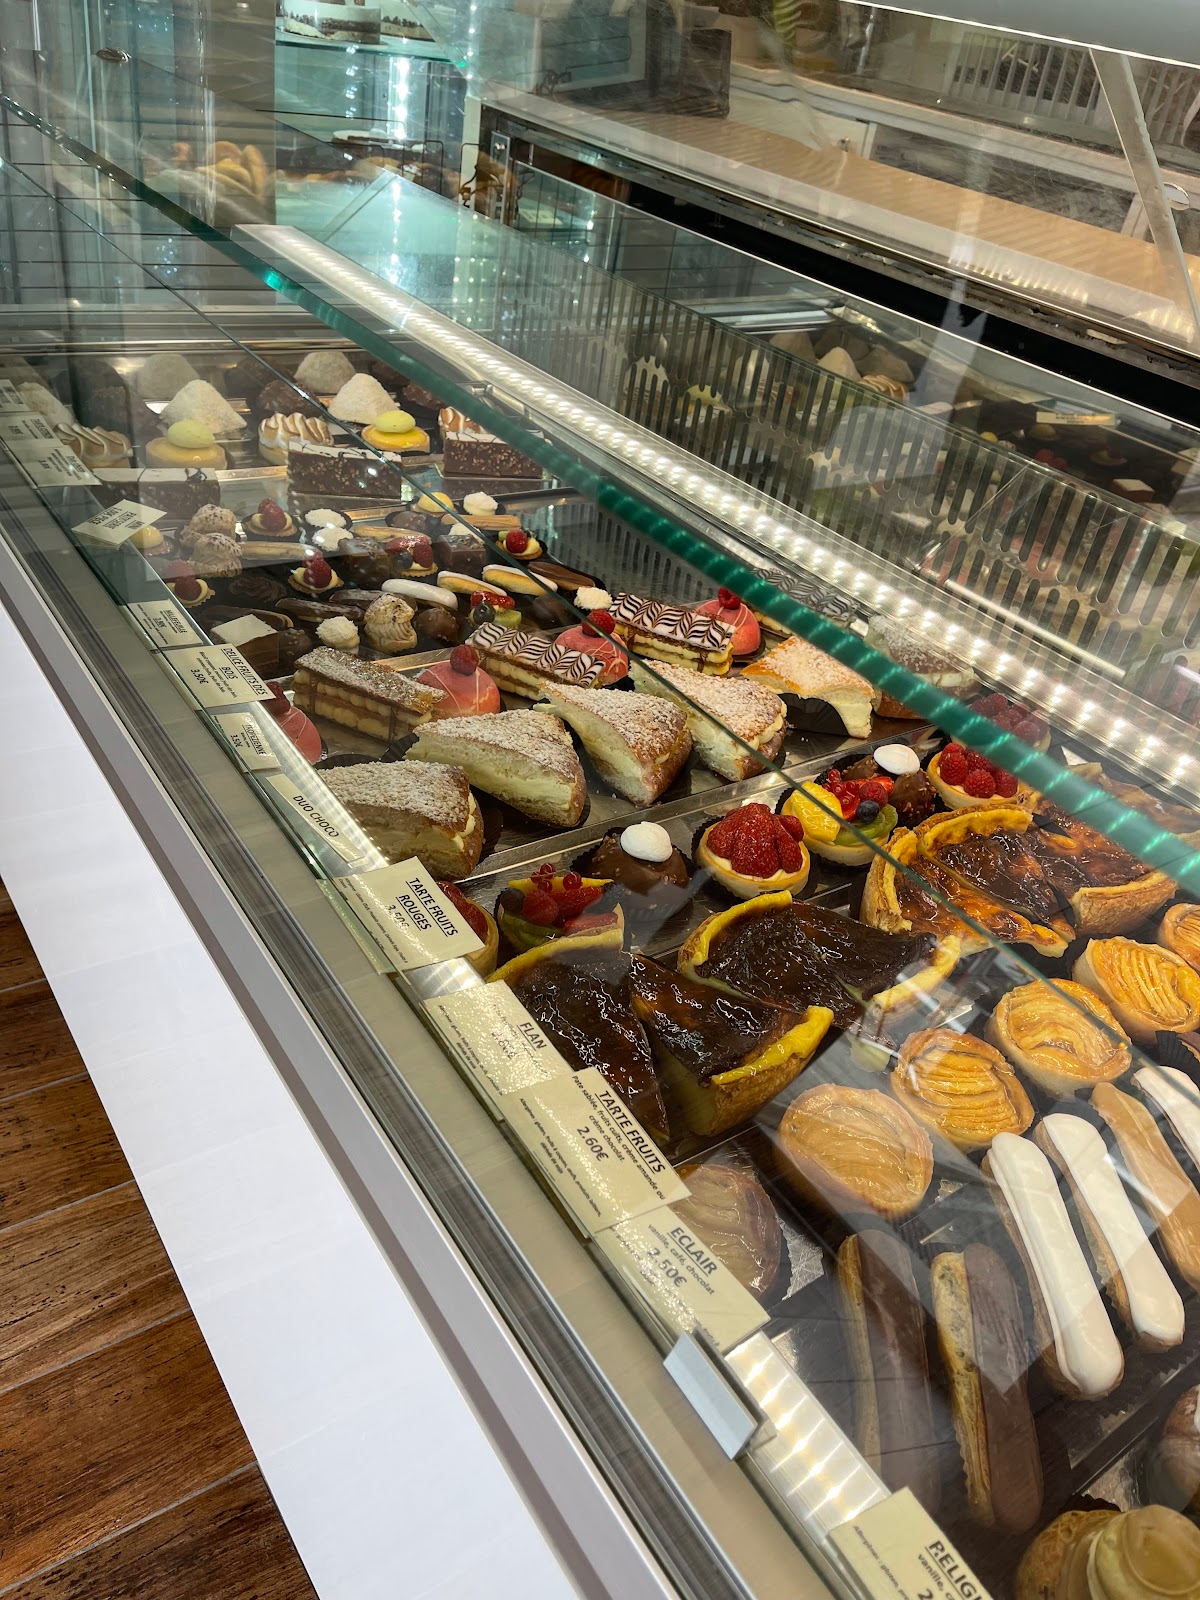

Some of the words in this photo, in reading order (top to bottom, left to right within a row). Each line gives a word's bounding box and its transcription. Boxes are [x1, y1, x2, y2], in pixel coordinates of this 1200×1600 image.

[191, 669, 208, 684] 3.50€
[222, 667, 238, 680] BOIS
[224, 648, 244, 665] DELICE
[238, 664, 258, 684] FRUITS
[252, 684, 268, 695] DES
[245, 724, 266, 754] TROPEZIENNE
[293, 796, 314, 812] DUO
[310, 812, 339, 838] CHOCO
[398, 894, 432, 930] ROUGES
[409, 878, 436, 906] TARTE
[429, 906, 458, 936] FRUITS
[520, 1022, 546, 1049] FLAN
[576, 1126, 609, 1162] 2.60€
[582, 1089, 598, 1110] sablée,
[597, 1110, 610, 1126] fruits
[610, 1126, 622, 1144] cuits,
[622, 1144, 638, 1163] crème
[636, 1163, 658, 1190] amande
[656, 1190, 666, 1200] ou
[589, 1115, 604, 1134] crème
[603, 1134, 625, 1163] chocolat.
[600, 1090, 632, 1128] TARTE
[626, 1130, 666, 1173] FRUITS
[648, 1224, 669, 1248] vanille,
[670, 1248, 685, 1266] café,
[686, 1265, 715, 1295] chocolat
[670, 1227, 718, 1274] ECLAIR
[918, 1554, 944, 1592] vanille,
